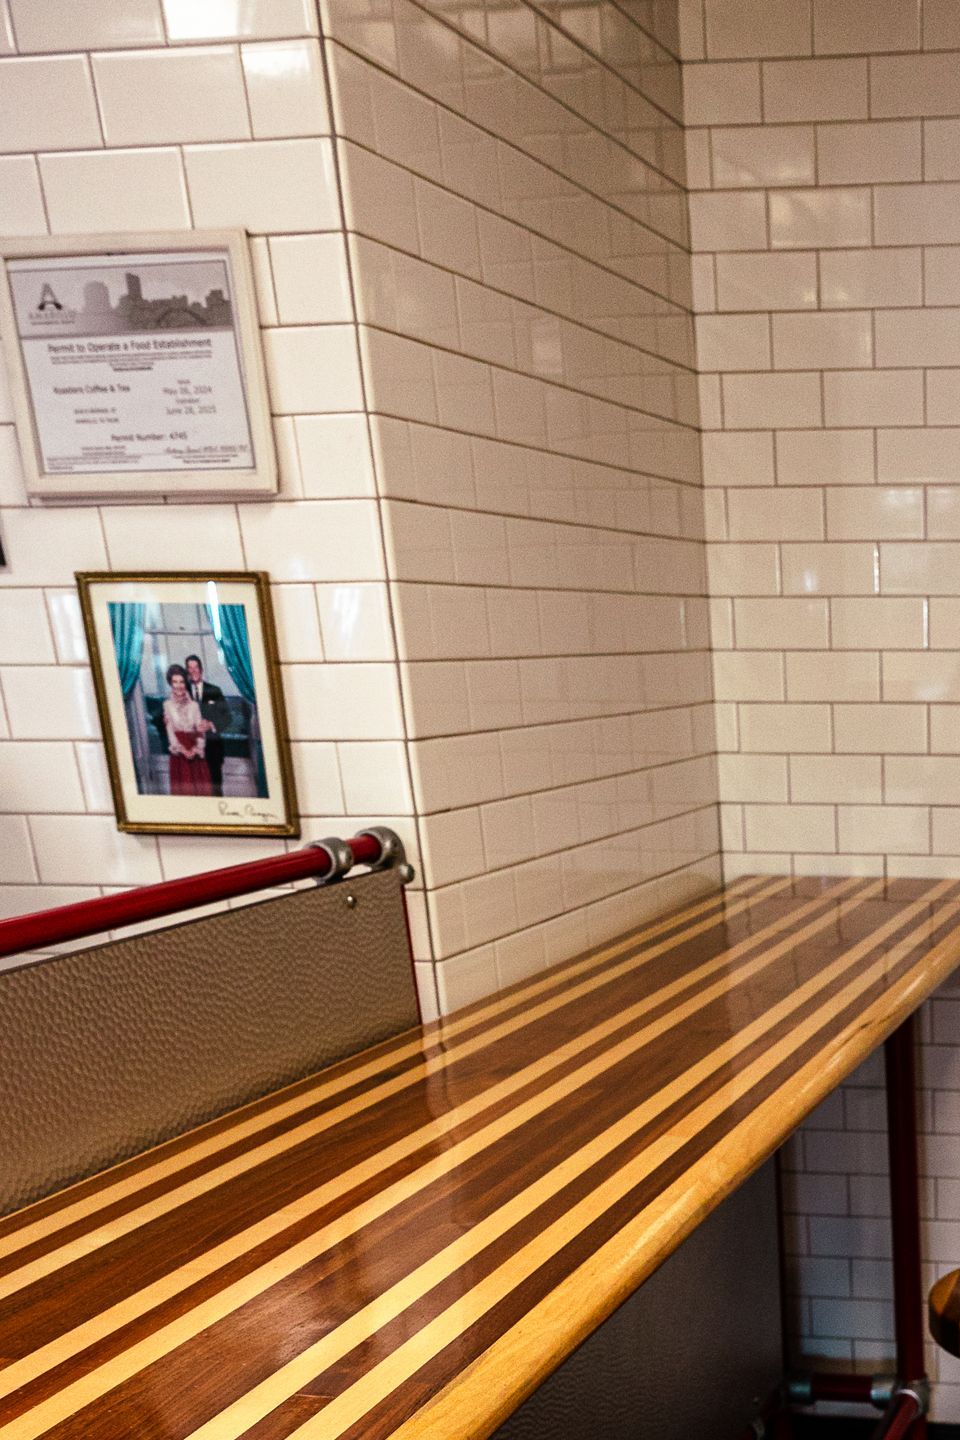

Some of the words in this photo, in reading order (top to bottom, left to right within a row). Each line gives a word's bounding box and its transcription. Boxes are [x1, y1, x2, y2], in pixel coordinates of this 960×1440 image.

[47, 343, 74, 353] Permit
[76, 343, 85, 352] to
[87, 341, 121, 353] Operate
[130, 340, 150, 350] Food
[152, 338, 212, 350] Establishment
[111, 433, 135, 442] Permit
